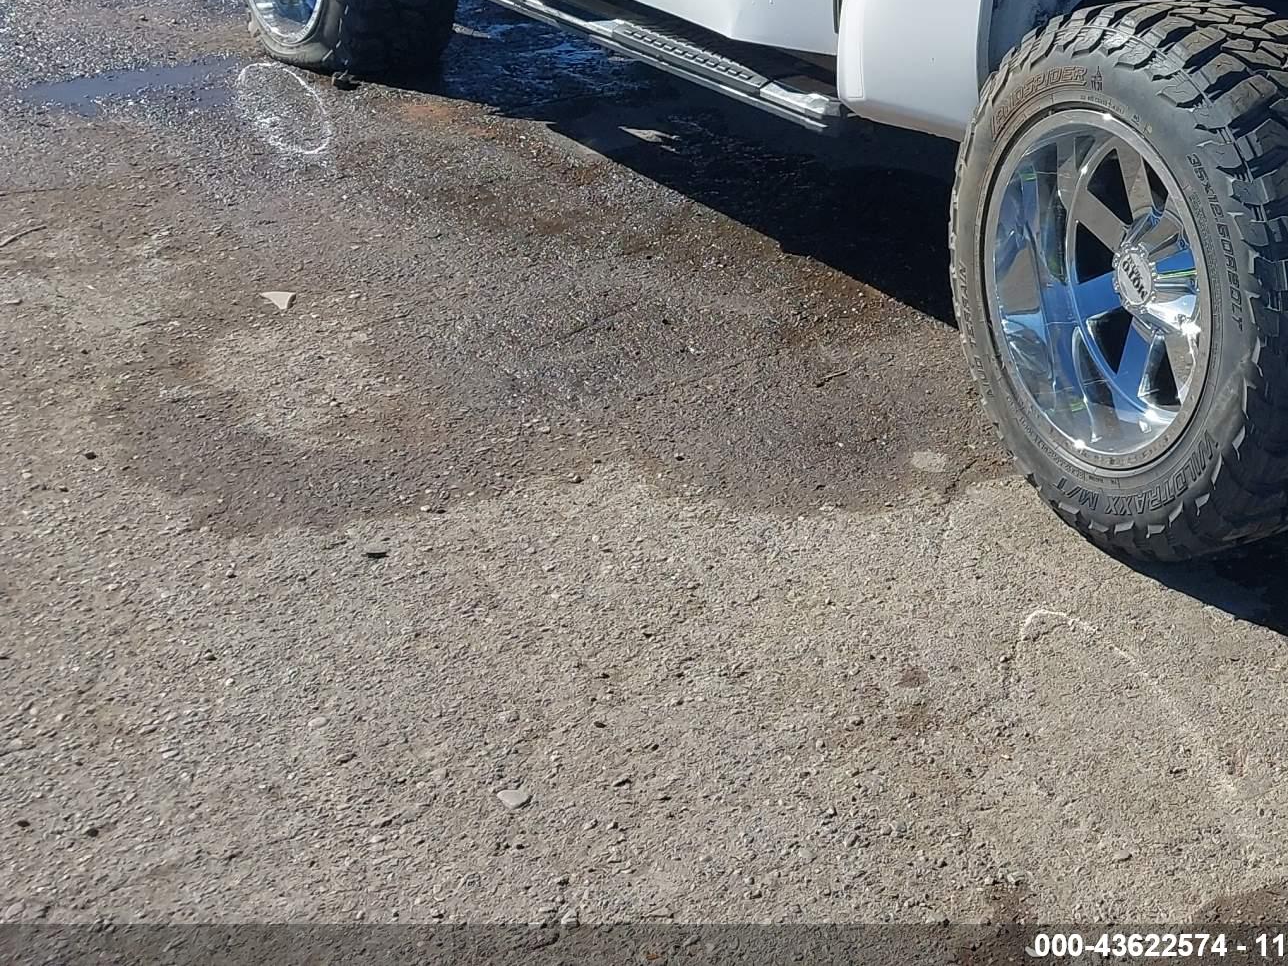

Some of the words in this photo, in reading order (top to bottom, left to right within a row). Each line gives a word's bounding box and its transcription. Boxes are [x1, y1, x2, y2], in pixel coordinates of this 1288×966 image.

[1122, 260, 1149, 301] MOTO
[1104, 429, 1220, 516] WILDTRAXX
[1053, 476, 1100, 511] M/T
